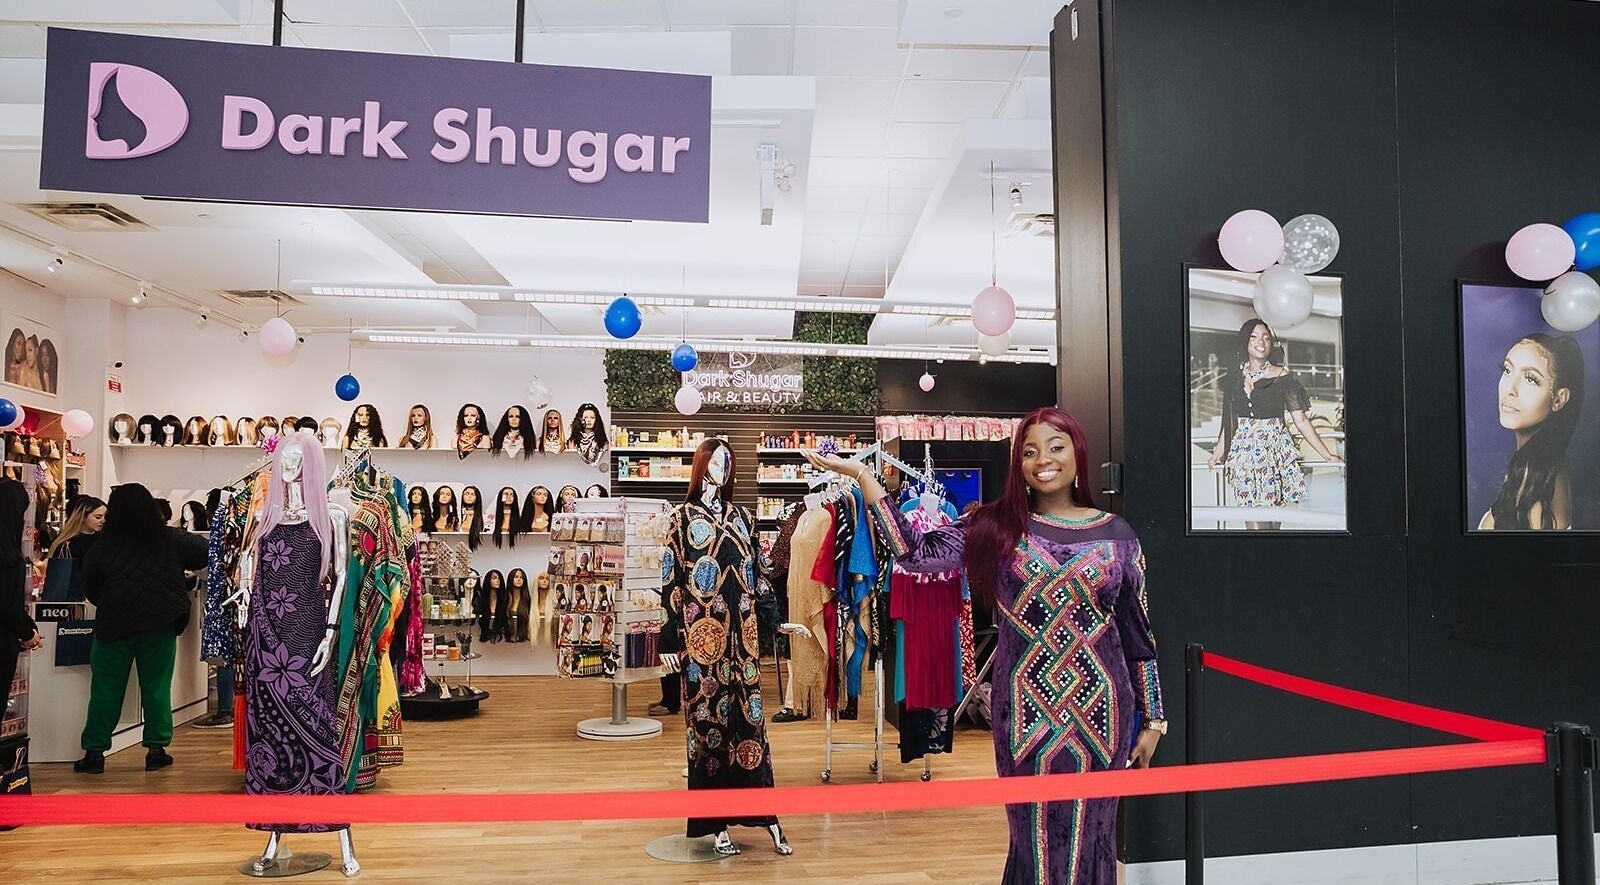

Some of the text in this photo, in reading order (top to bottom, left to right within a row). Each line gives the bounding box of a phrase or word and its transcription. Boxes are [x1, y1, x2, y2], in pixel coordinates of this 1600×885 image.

[221, 95, 691, 184] Dark Shugar
[682, 369, 802, 392] Dark Shugar
[699, 391, 801, 404] AIR & BEAUTY
[42, 608, 70, 618] neo
